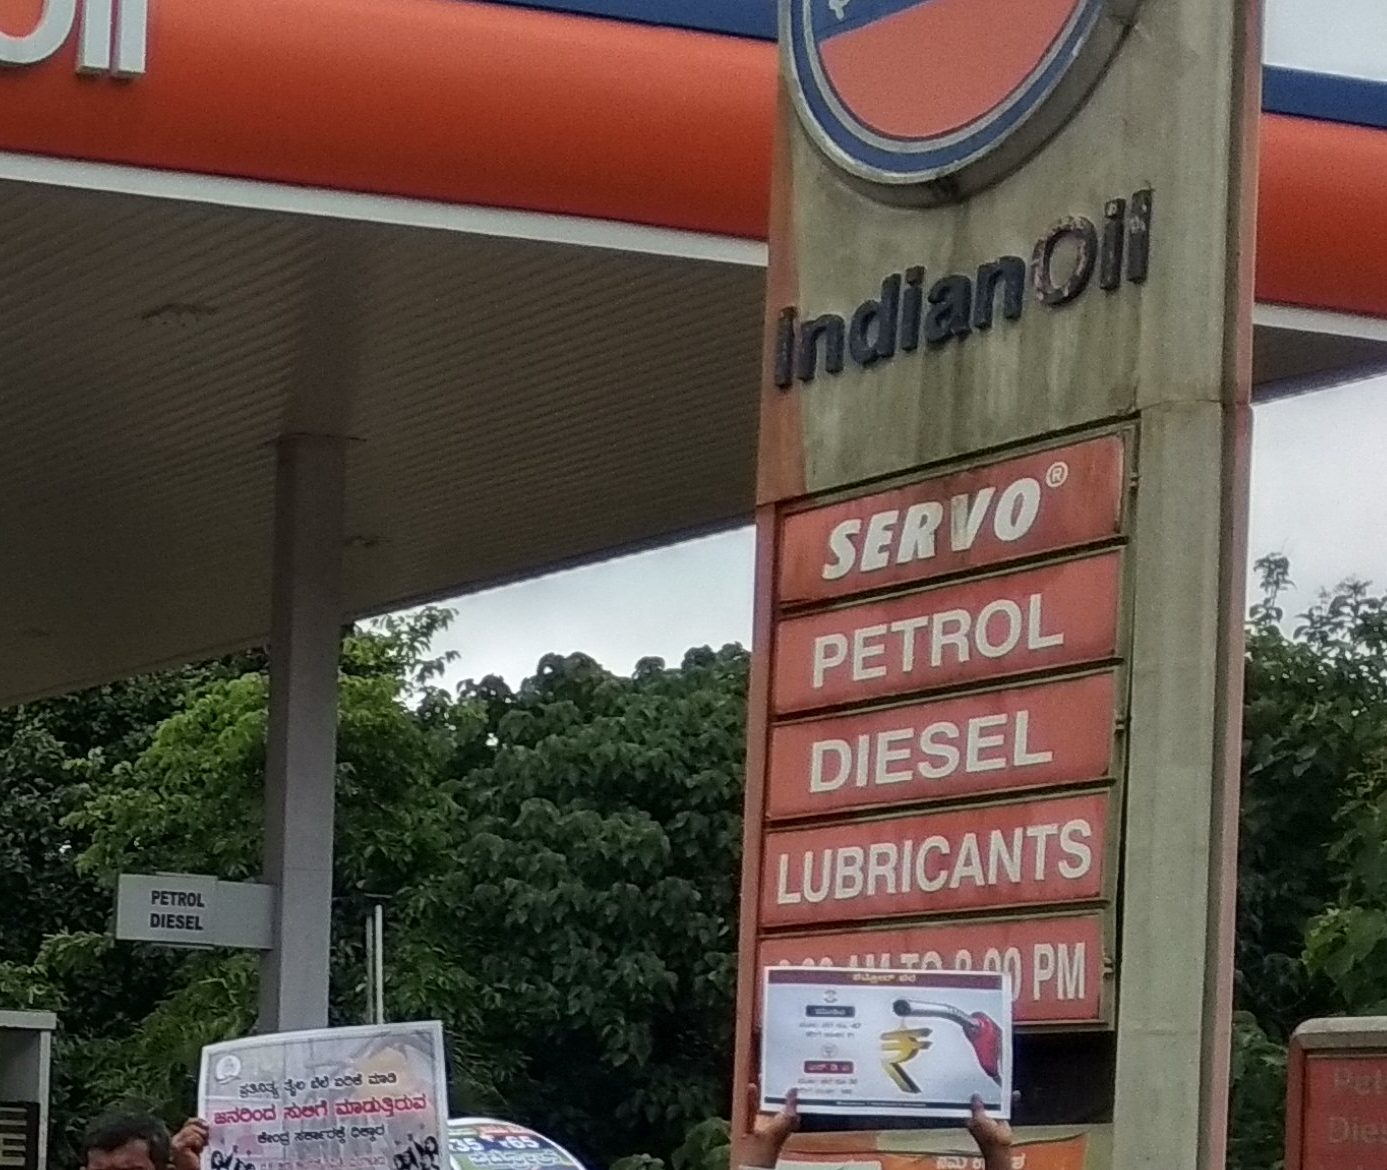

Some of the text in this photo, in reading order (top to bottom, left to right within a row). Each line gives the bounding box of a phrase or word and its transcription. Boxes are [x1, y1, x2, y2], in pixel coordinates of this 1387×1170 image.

[774, 187, 1153, 389] IndianOil
[813, 593, 1064, 689] PETROL
[809, 709, 1053, 793] DIESEL
[778, 819, 1092, 905] LUBRICANTS
[150, 913, 203, 930] DIESEL
[151, 890, 204, 907] PETROL
[1033, 943, 1085, 1000] PM
[213, 1103, 276, 1126] ಜನರಿಂದ
[334, 1093, 427, 1119] ಮಾಡುತ್ತಿರುವ
